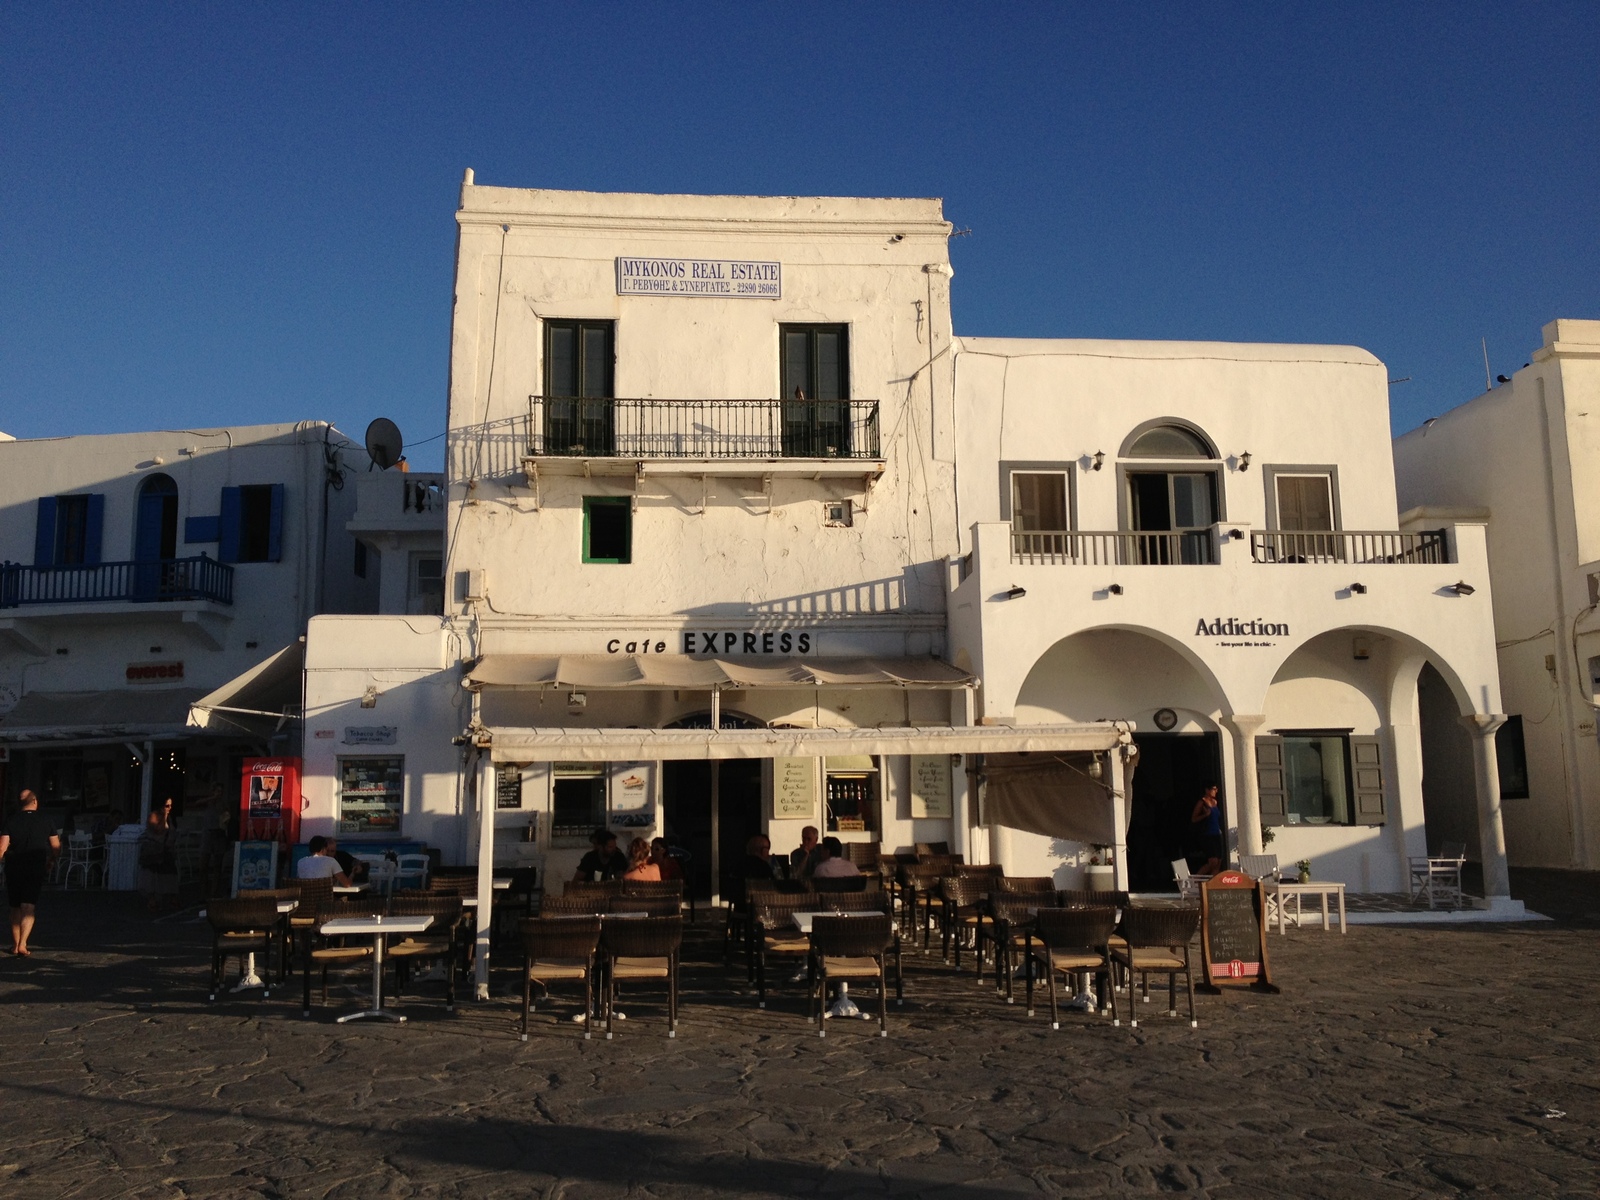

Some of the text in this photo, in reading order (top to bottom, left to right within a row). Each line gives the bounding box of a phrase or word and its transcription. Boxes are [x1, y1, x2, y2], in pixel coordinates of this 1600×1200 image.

[623, 260, 778, 280] MYKONOS REAL ESTATE
[737, 282, 757, 294] 22890
[758, 283, 778, 294] 26066
[1195, 617, 1290, 636] Addiction
[606, 632, 811, 654] Cafe EXPRESS
[126, 662, 184, 680] everest
